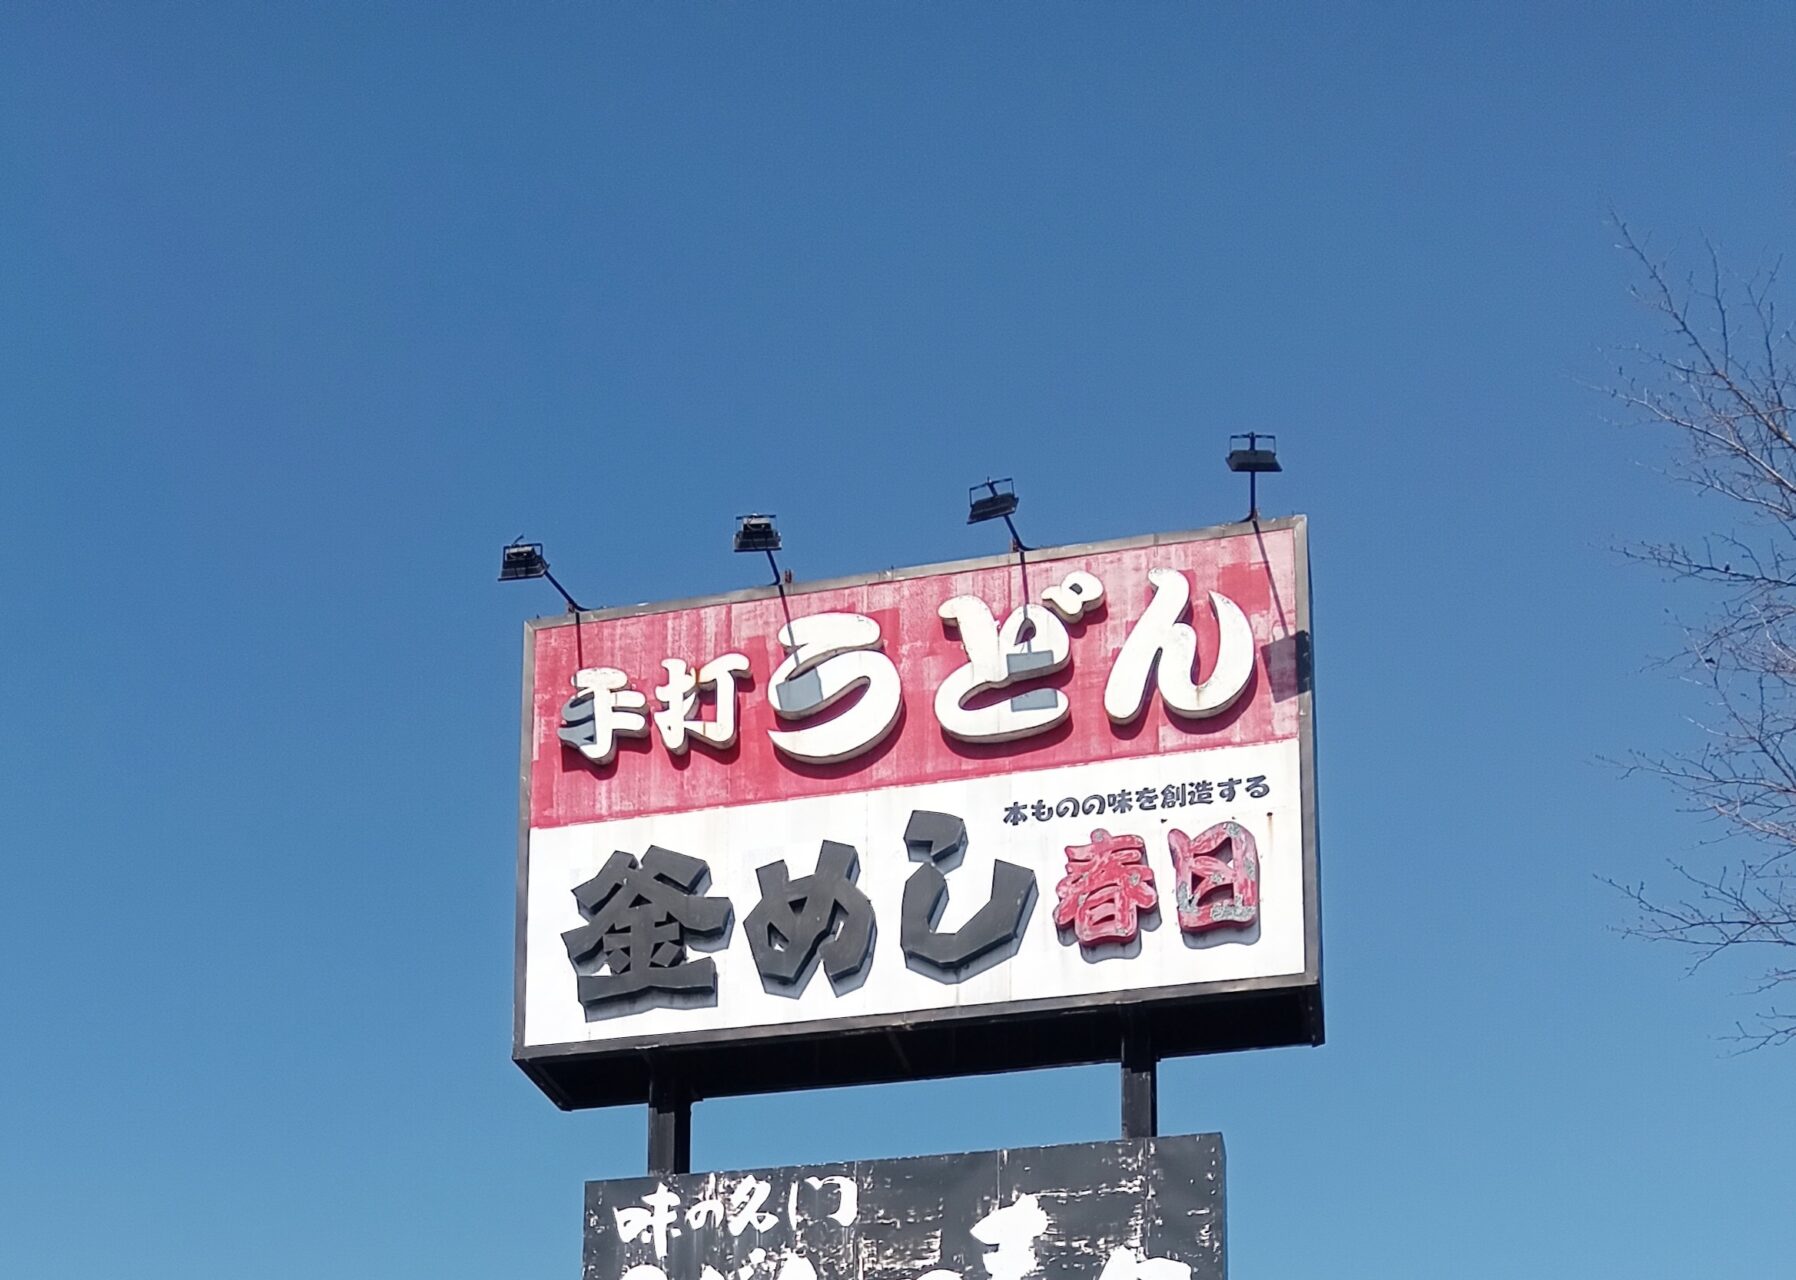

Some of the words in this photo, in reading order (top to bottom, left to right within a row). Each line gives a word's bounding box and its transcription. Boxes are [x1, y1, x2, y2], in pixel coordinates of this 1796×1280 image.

[1002, 774, 1271, 827] 本ものの味を創造する
[560, 809, 1038, 1010] 釜めし
[1053, 820, 1260, 947] 春日
